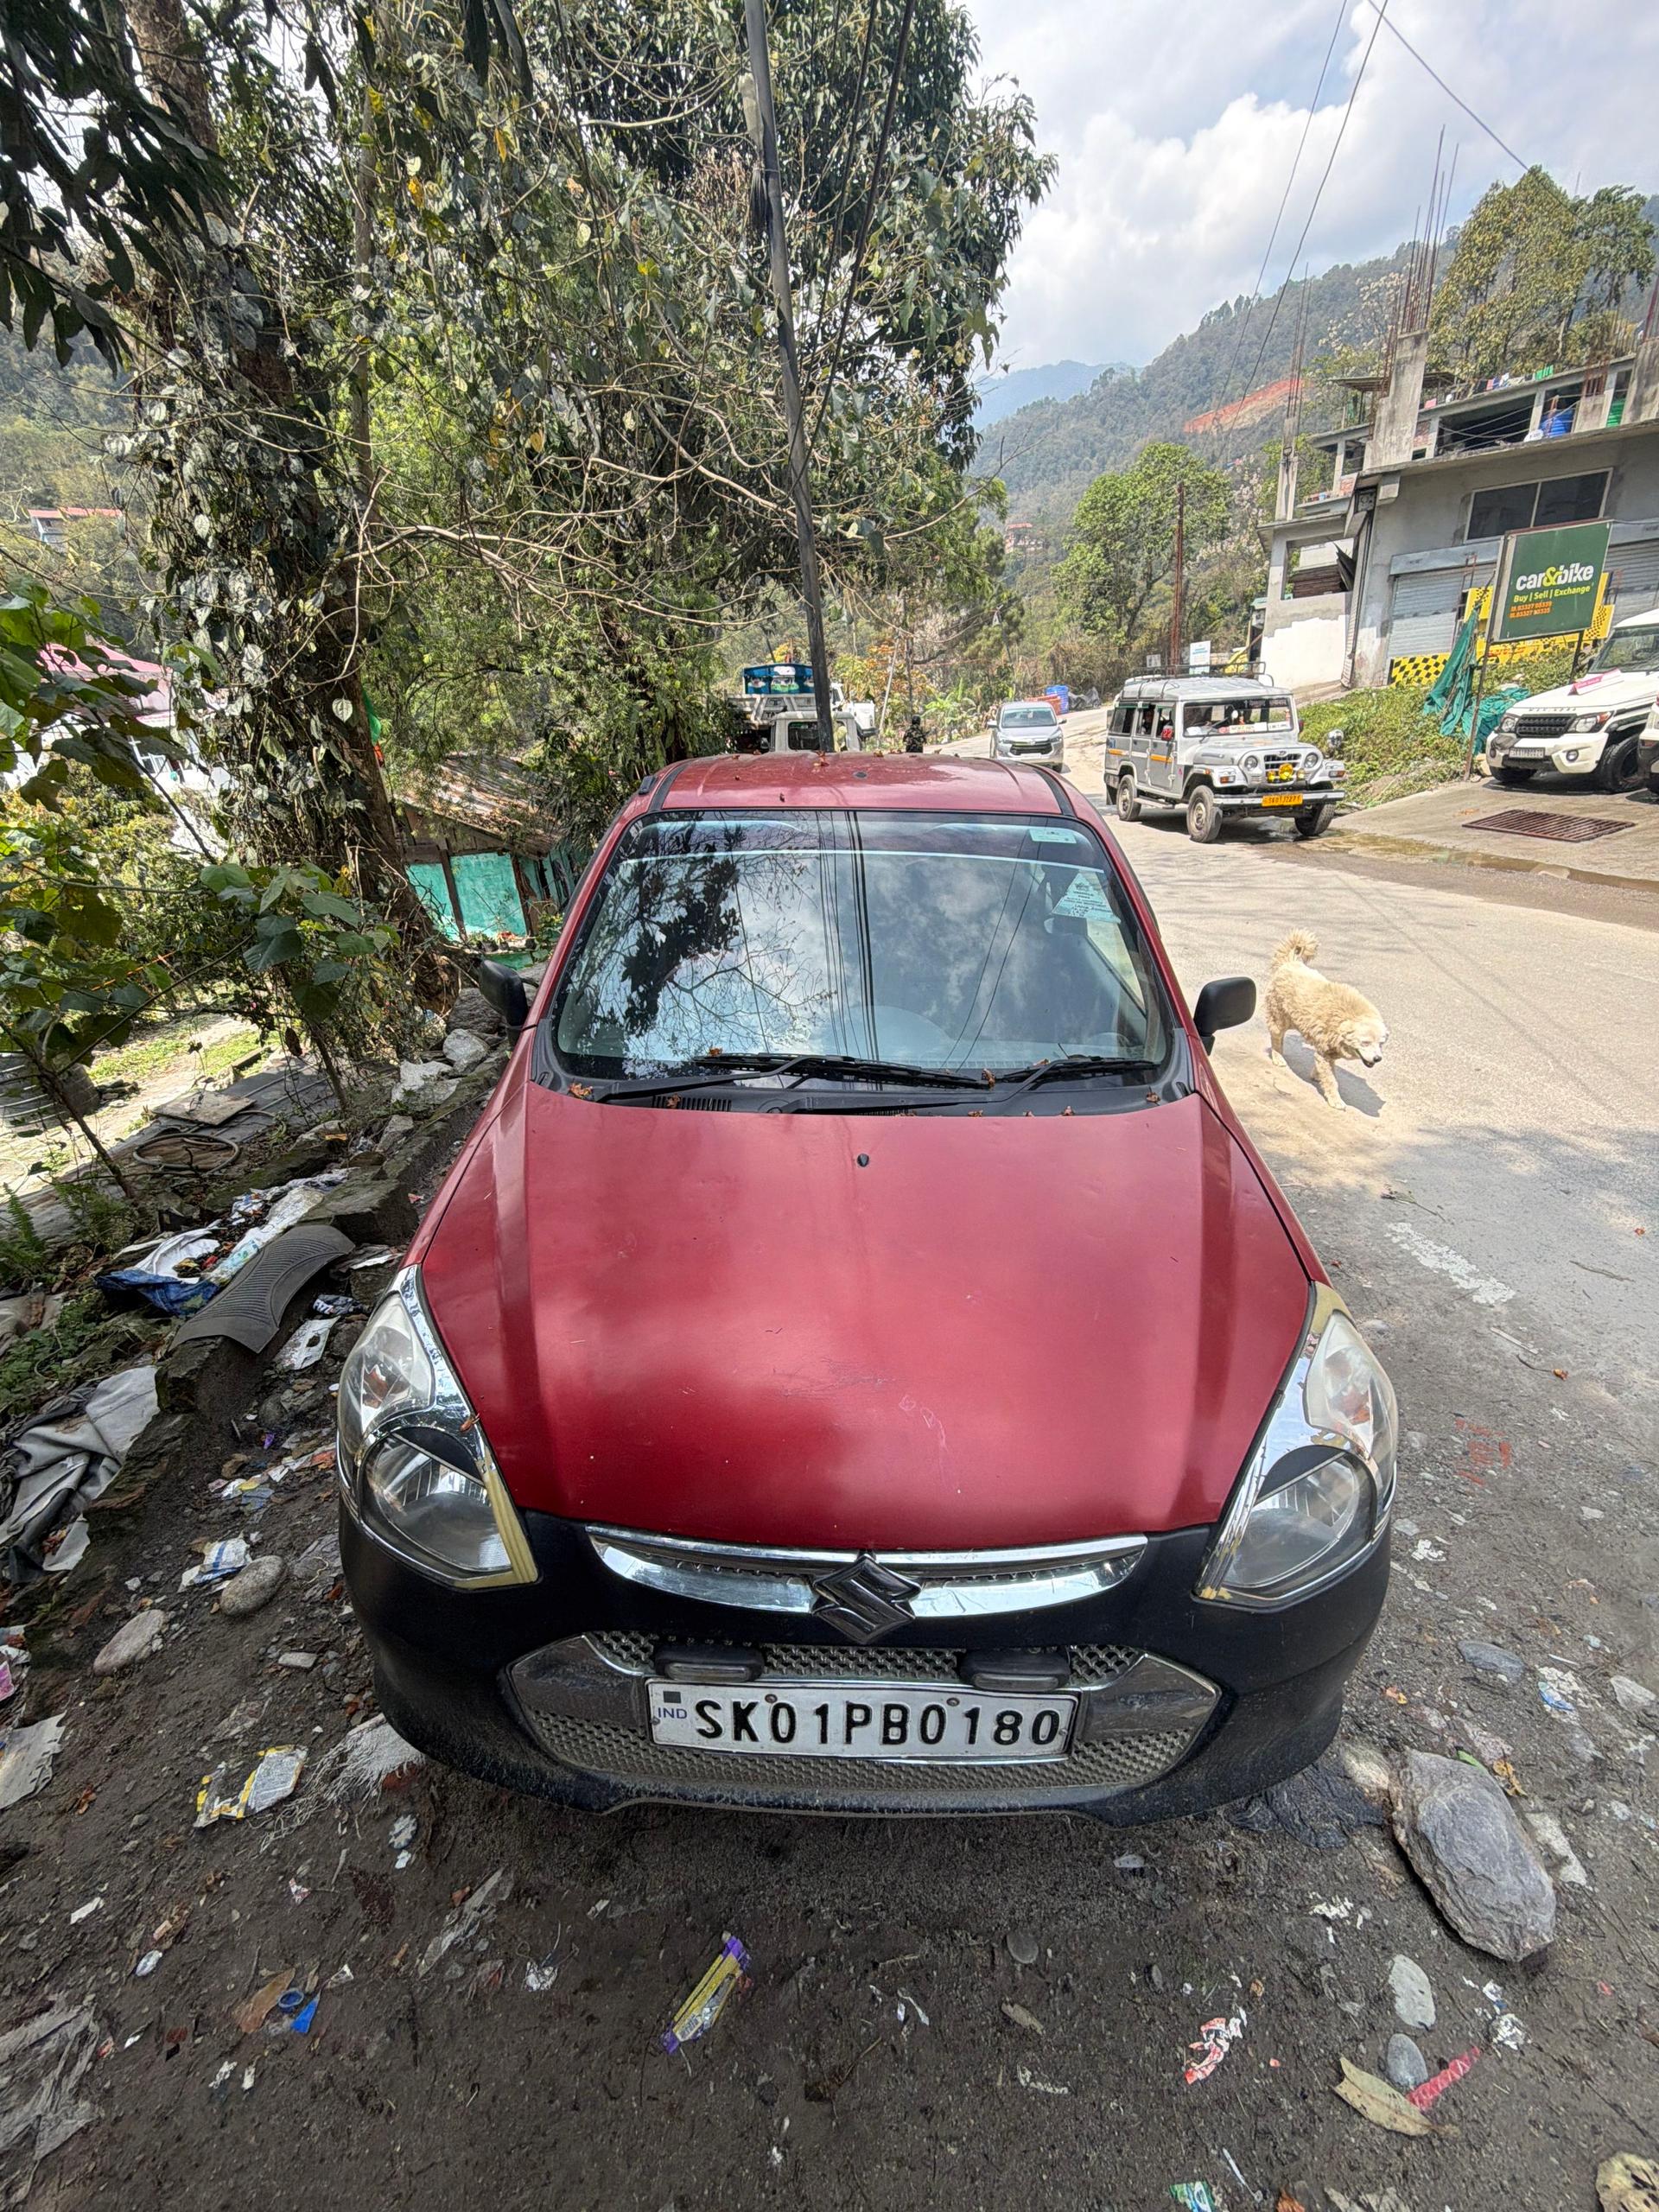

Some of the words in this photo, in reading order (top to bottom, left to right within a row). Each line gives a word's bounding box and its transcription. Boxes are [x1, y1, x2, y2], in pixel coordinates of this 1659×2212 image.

[1516, 563, 1594, 591] car&bike
[1514, 594, 1529, 603] Buy
[1534, 589, 1548, 600] Sell
[1554, 585, 1591, 597] Exchange
[658, 1707, 688, 1719] IND
[695, 1699, 1061, 1745] SK01PB0180
